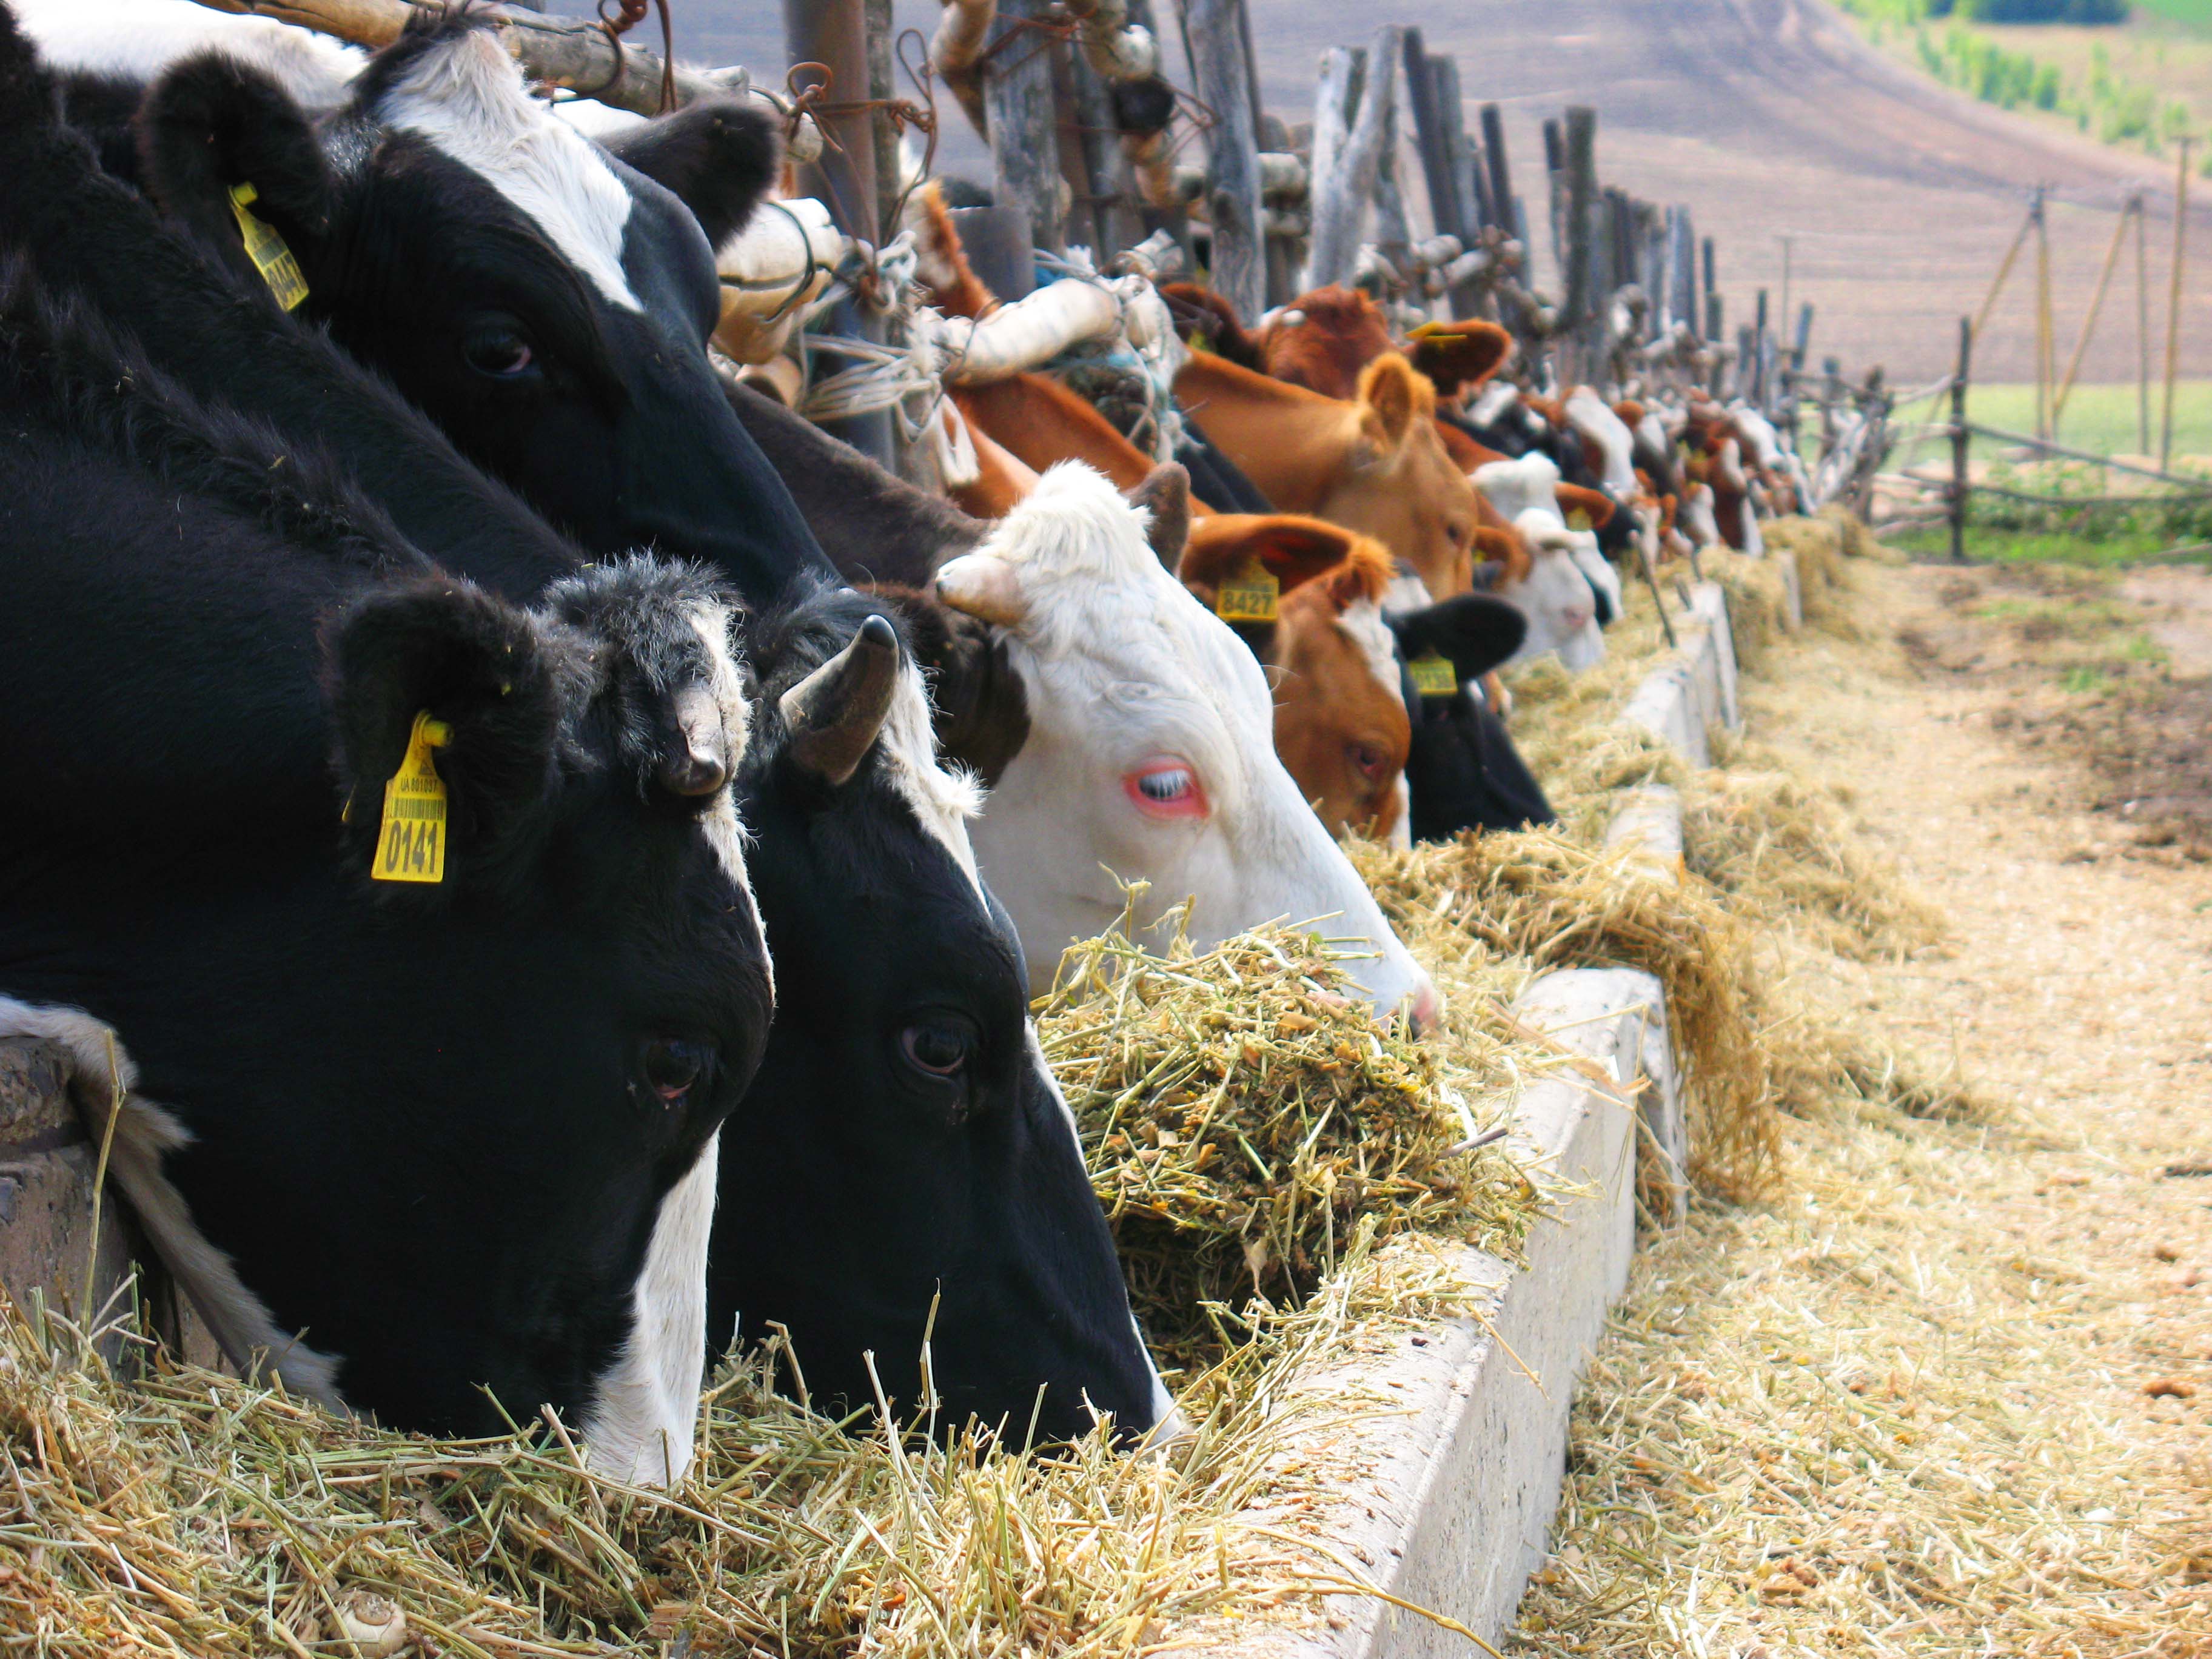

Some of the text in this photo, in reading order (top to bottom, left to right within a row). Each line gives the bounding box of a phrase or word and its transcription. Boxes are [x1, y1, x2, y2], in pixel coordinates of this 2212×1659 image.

[1224, 590, 1272, 614] 8427
[400, 776, 410, 792] UA
[386, 820, 437, 874] 0141
